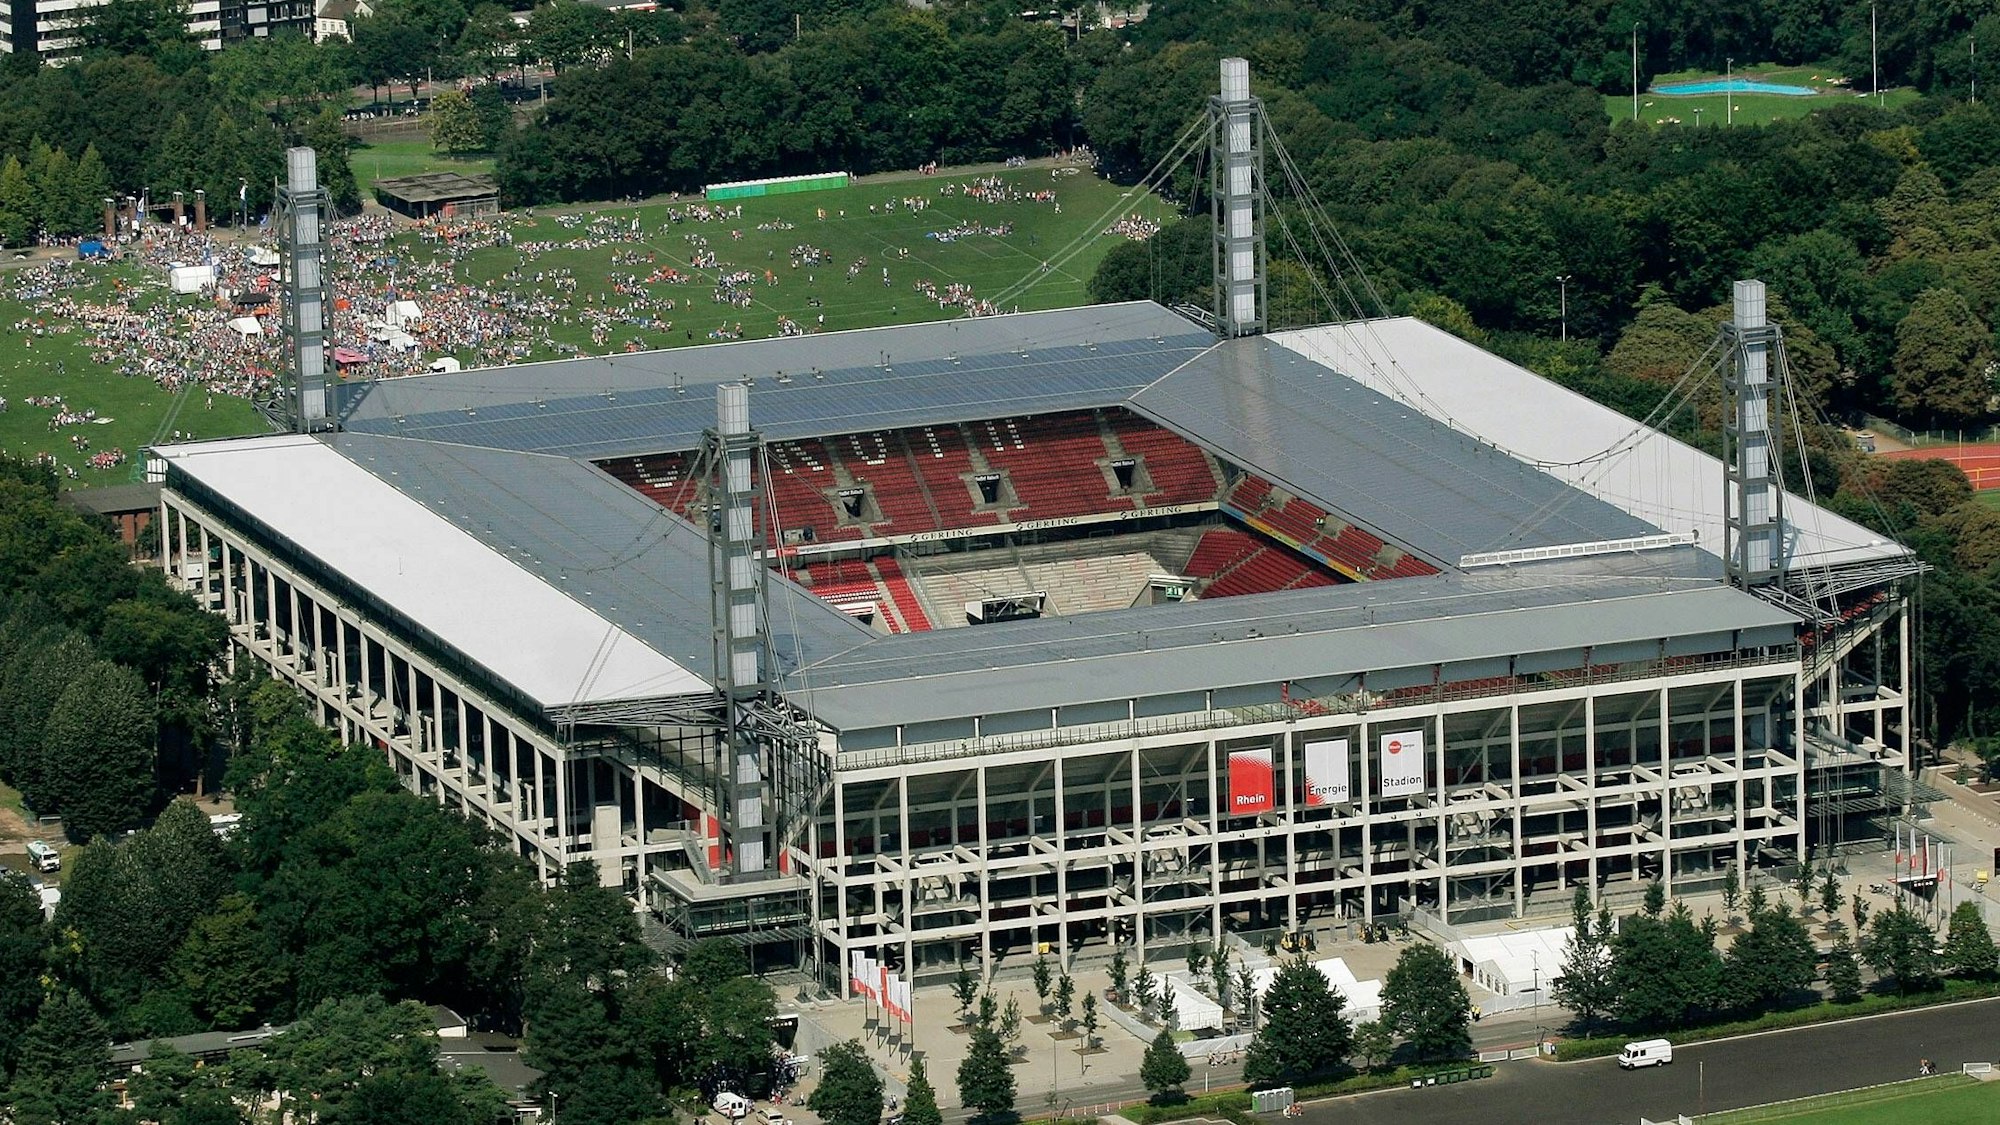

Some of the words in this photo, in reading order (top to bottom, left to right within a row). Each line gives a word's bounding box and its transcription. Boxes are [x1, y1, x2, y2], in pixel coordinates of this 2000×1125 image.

[1131, 505, 1182, 518] GERLING
[1027, 517, 1078, 529] GERLING
[921, 528, 973, 541] GERLING
[1383, 775, 1422, 788] Stadion
[1308, 783, 1347, 796] Energie
[1236, 793, 1265, 806] Rhein
